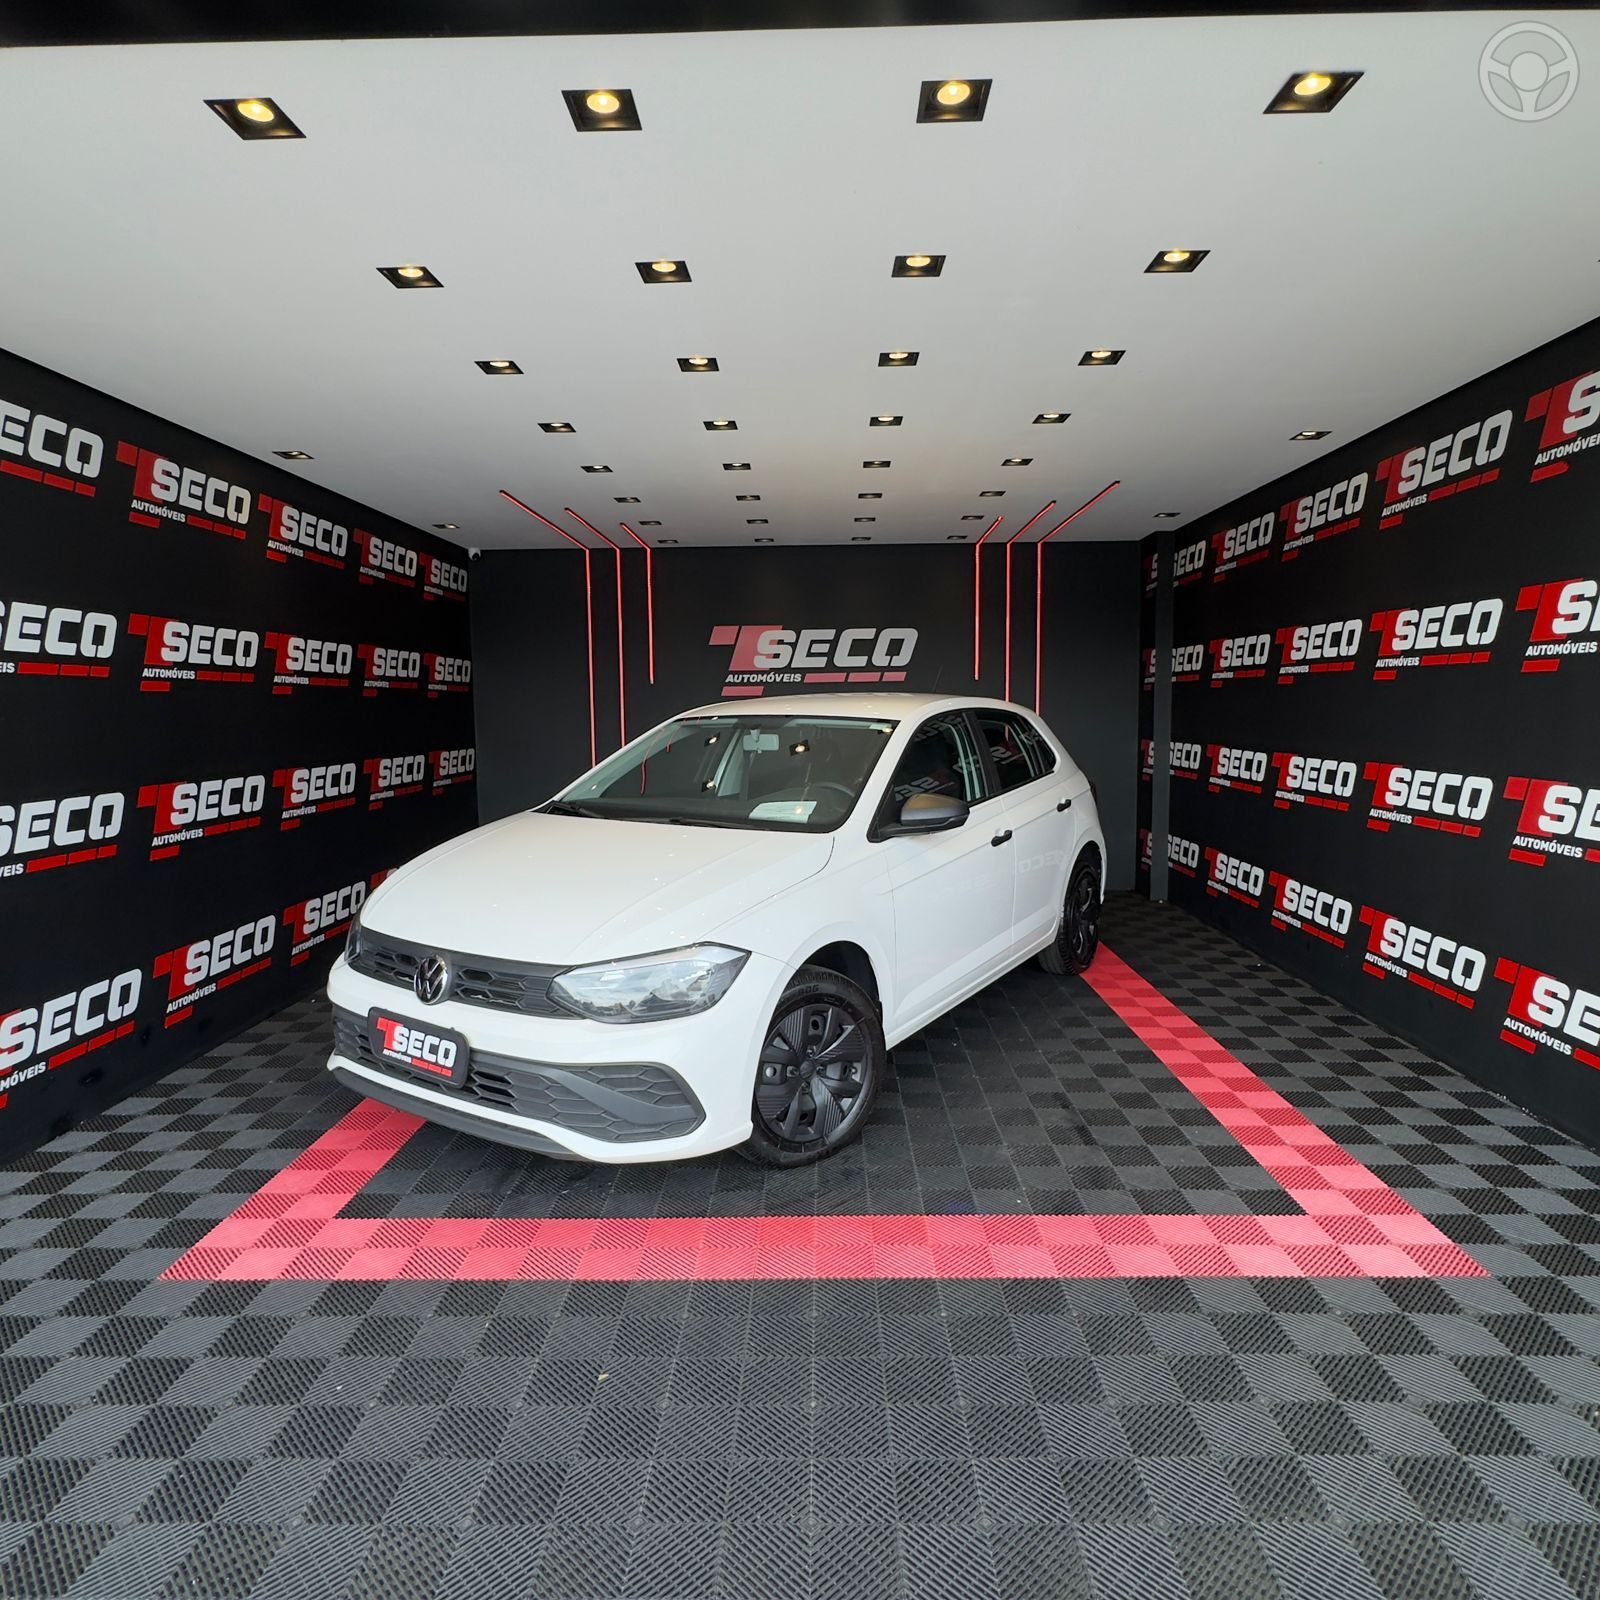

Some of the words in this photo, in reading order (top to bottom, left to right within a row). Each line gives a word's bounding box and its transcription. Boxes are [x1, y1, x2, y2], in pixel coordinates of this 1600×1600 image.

[131, 499, 186, 523] AUTOMÓVEIS
[1381, 494, 1427, 517] AUTOMÓVEIS
[1525, 640, 1598, 657] AUTOMÓVEIS
[1375, 655, 1420, 668] AUTOMÓVEIS
[142, 667, 196, 680] AUTOMÓVEIS
[724, 671, 803, 683] AUTOMÓVEIS
[1369, 807, 1413, 825] AUTOMÓVEIS
[152, 828, 203, 847] AUTOMÓVEIS
[1512, 834, 1583, 859] AUTOMÓVEIS
[1364, 951, 1407, 979] AUTOMÓVEIS
[166, 982, 217, 1014] AUTOMÓVEIS
[1504, 1016, 1572, 1056] AUTOMÓVEIS
